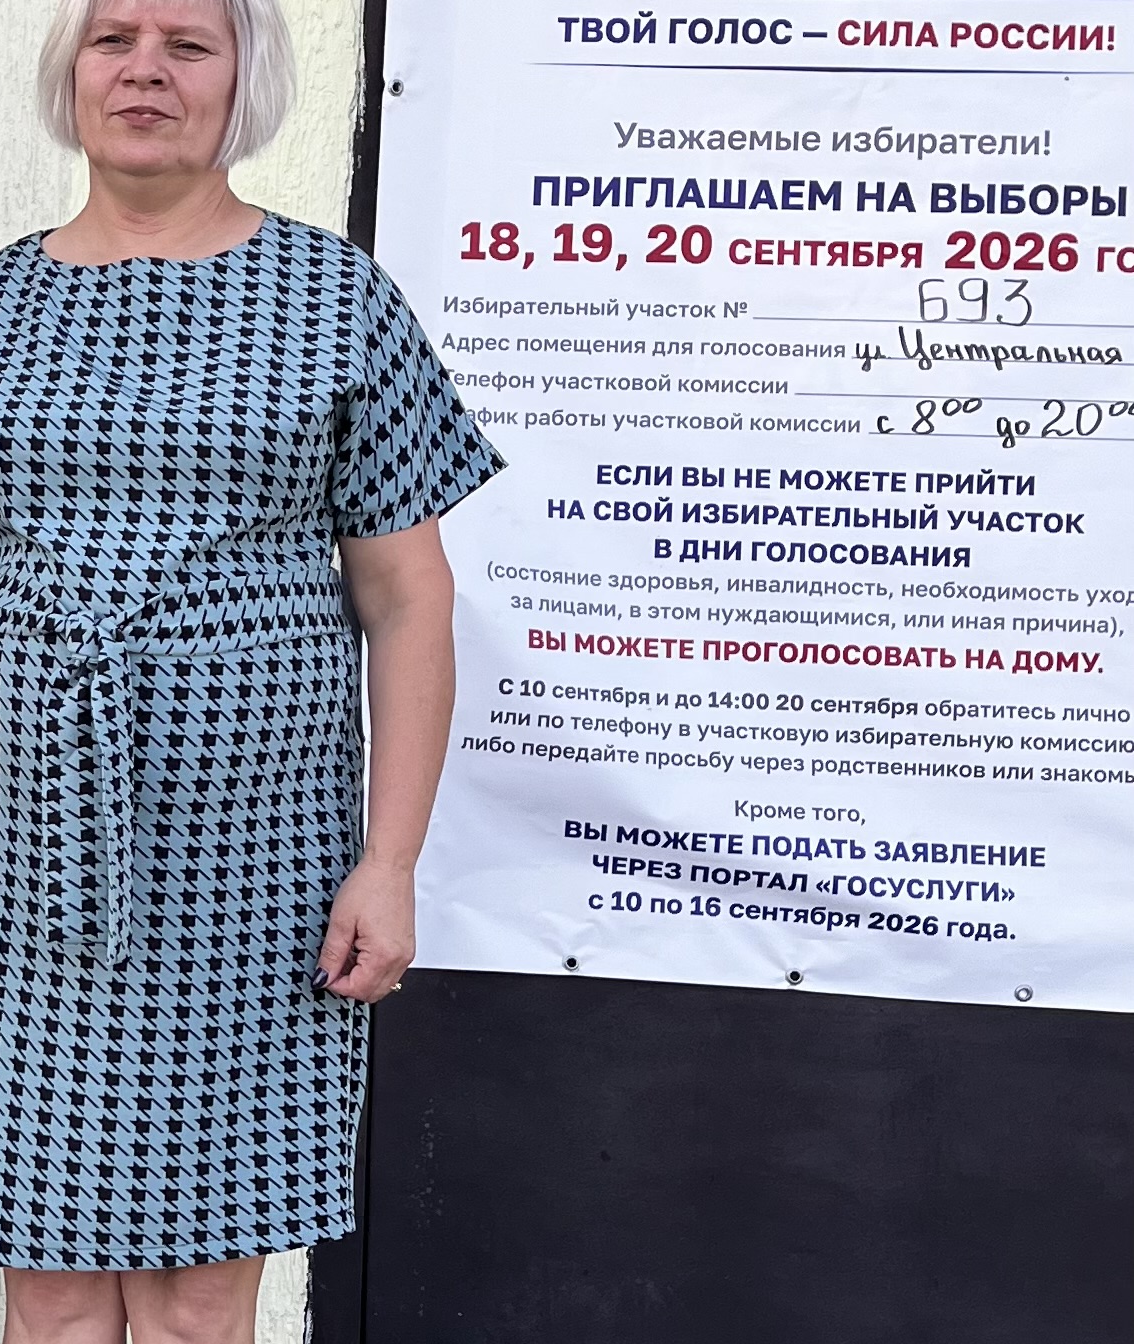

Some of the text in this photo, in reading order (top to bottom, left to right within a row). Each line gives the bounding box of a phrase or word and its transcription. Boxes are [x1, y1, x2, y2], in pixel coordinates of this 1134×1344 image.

[558, 11, 657, 44] ТВОЙ
[669, 18, 792, 45] ГОЛОС
[838, 20, 938, 47] СИЛА
[950, 22, 1114, 51] РОССИИ!
[614, 122, 1050, 160] Уважаемые избиратели!
[533, 176, 1127, 217] ПРИГЛАШАЕМ НА ВЫБОРЫ
[461, 222, 1134, 273] 18, 19, 20 СЕНТЯБРЯ 2026 ГО
[444, 296, 747, 321] Избирательный участок №
[918, 277, 1033, 326] 693
[442, 333, 845, 357] Адрес помещения для голосования
[541, 374, 670, 393] участковой
[678, 379, 788, 394] комиссии
[466, 407, 860, 433] афик работы участковой комиссии
[877, 415, 894, 433] с
[996, 416, 1030, 448] до
[597, 464, 1035, 496] ЕСЛИ ВЫ НЕ МОЖЕТЕ ПРИЙТИ
[548, 497, 1084, 534] НА СВОЙ ИЗБИРАТЕЛЬНЫЙ УЧАСТОК
[654, 539, 970, 568] В ДНИ ГОЛОСОВАНИЯ
[488, 561, 1134, 607] (состояние здоровья, инвалидность, необходимость уход
[511, 596, 1124, 638] за лицами, в этом нуждающимися, или иная причина),
[529, 629, 1103, 674] ВЫ МОЖЕТЕ ПРОГОЛОСОВАТЬ НА ДОМУ.
[499, 678, 1130, 722] С 10 сентября и до 14:00 20 сентября обратитесь лично
[490, 710, 1134, 753] или по телефону в участковую избирательную комиссию
[461, 736, 1134, 783] либо передайте просьбу через родственников или знаком
[735, 800, 865, 826] Кроме того,
[564, 820, 1045, 867] ВЫ МОЖЕТЕ ПОДАТЬ ЗАЯВЛЕНИЕ
[592, 854, 1015, 902] ЧЕРЕЗ ПОРТАЛ «ГОСУСЛУГИ»
[588, 891, 1016, 942] с 10 по 16 сентября 2026 года.
